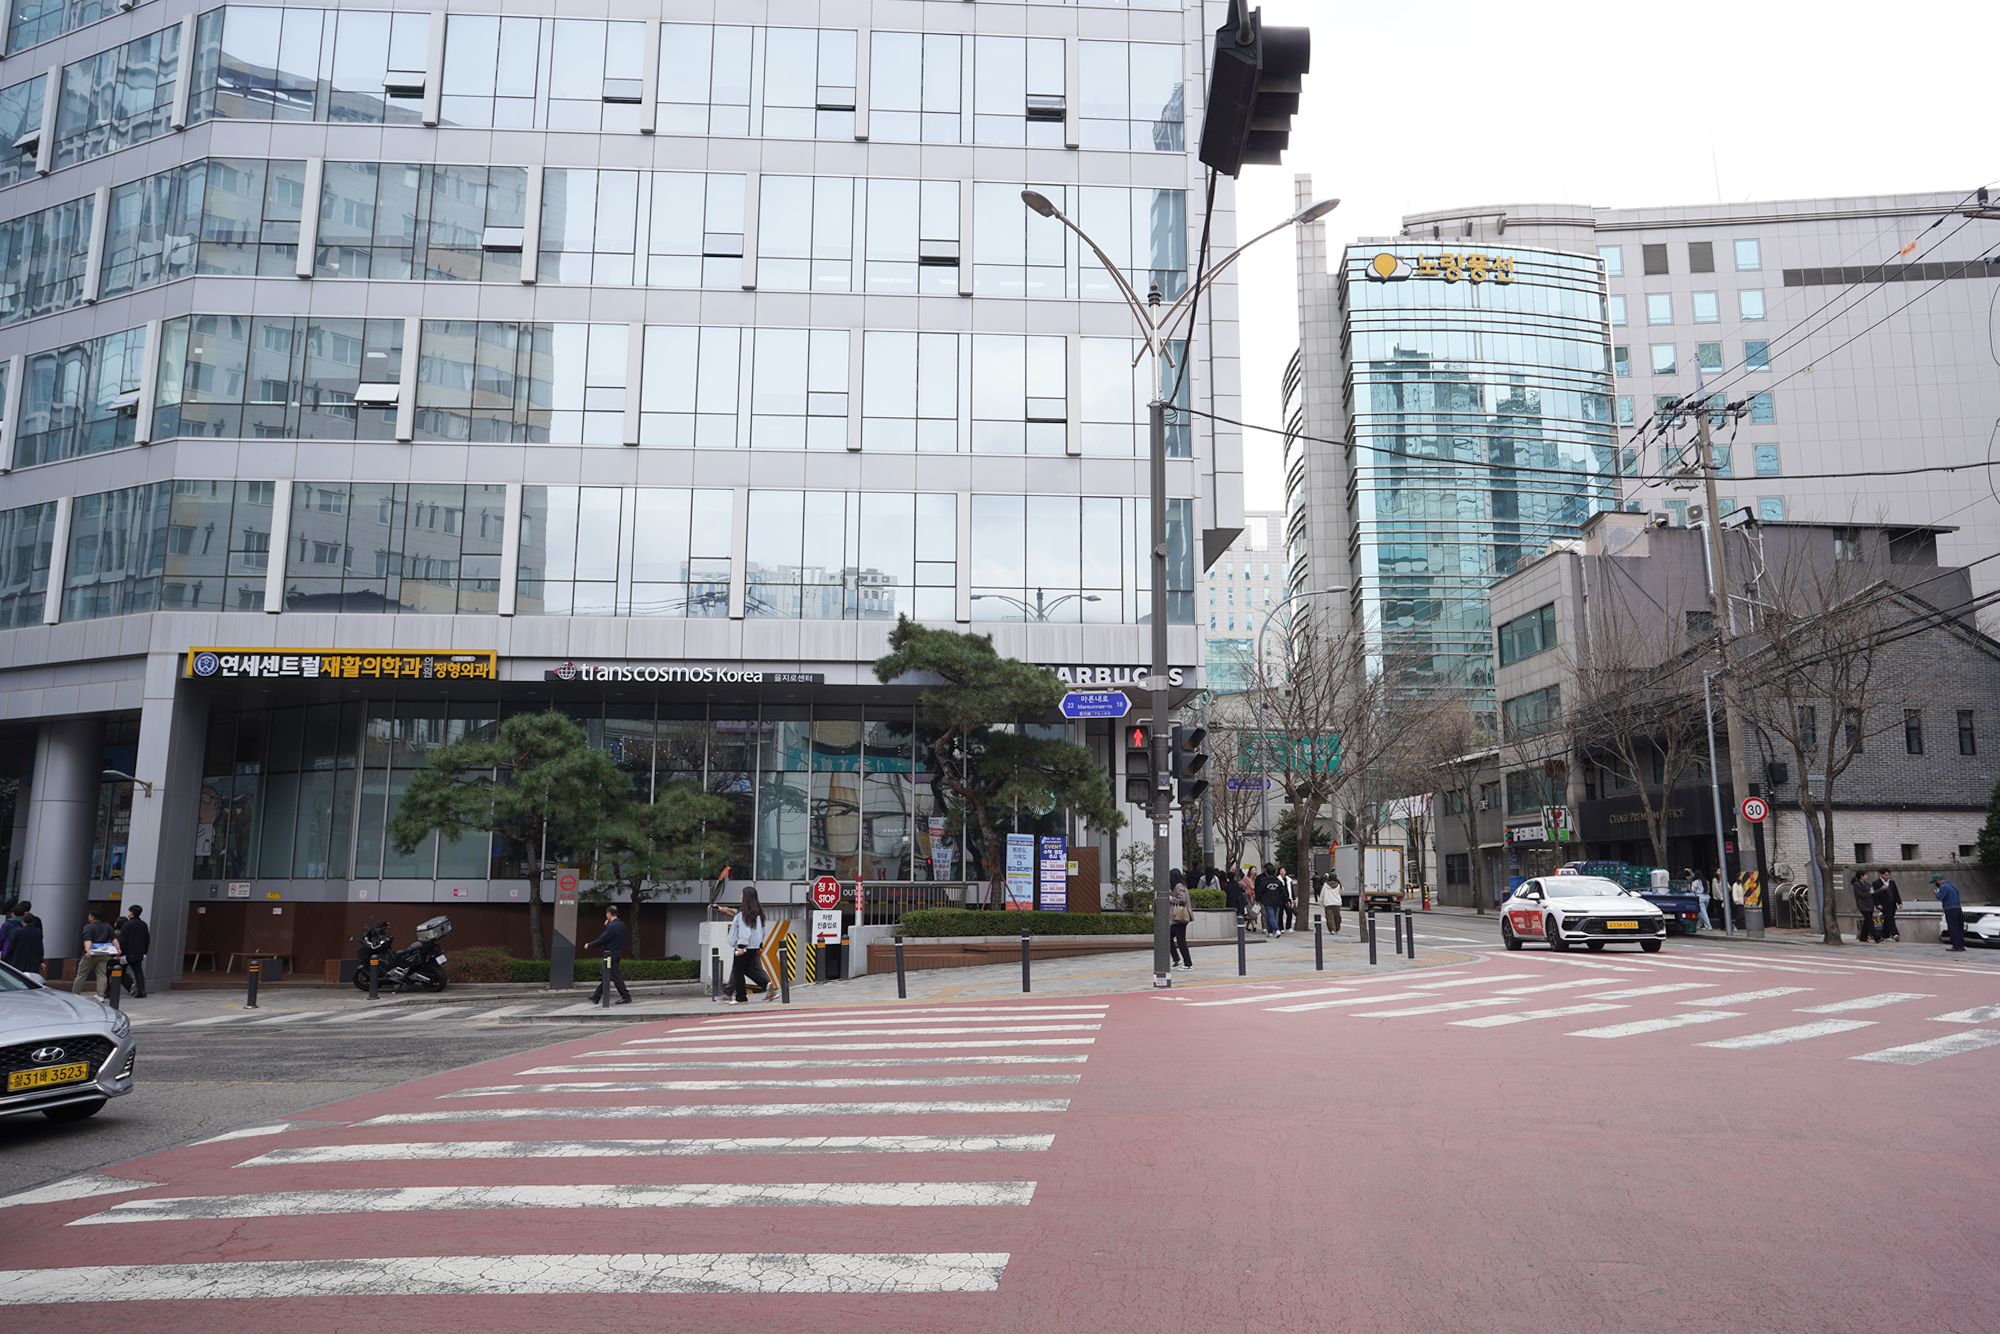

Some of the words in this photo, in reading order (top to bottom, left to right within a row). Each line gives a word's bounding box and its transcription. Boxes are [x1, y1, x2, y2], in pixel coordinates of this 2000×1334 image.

[1416, 252, 1515, 284] 노랑풍선
[434, 662, 489, 679] 정형외과
[580, 663, 713, 682] transcosmos
[716, 668, 763, 683] Korea
[774, 673, 813, 683] 을지로센터
[1747, 804, 1762, 816] 30
[818, 895, 835, 903] STOP
